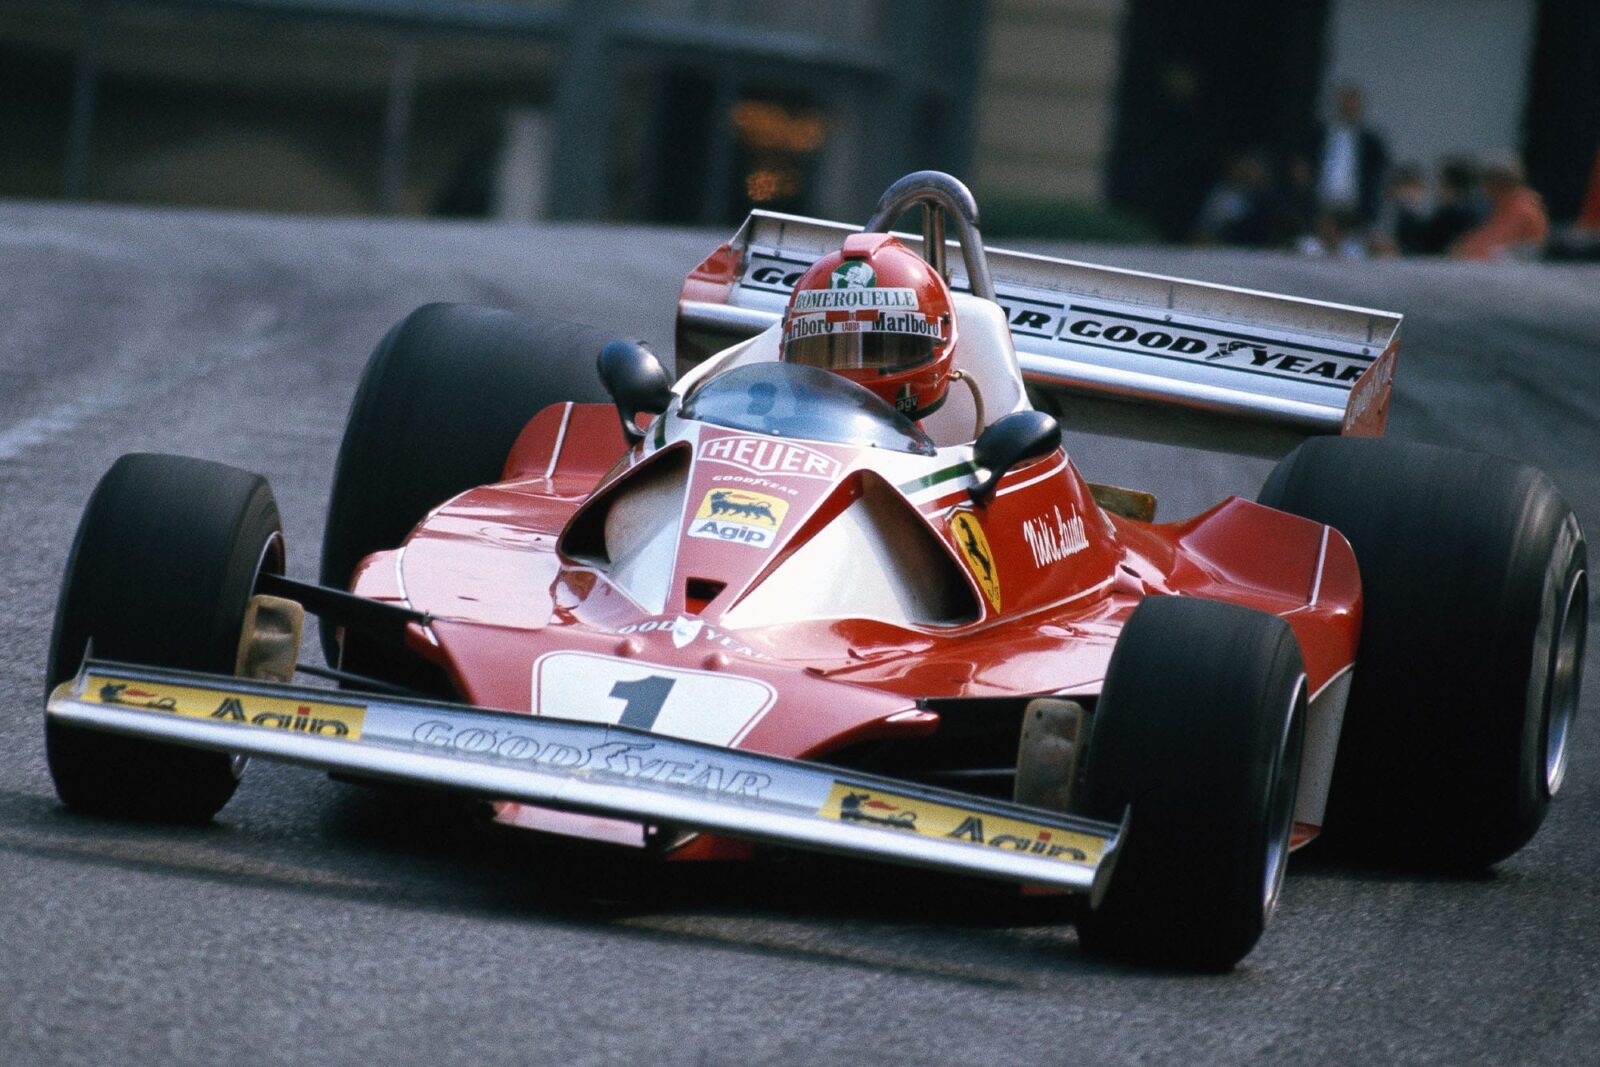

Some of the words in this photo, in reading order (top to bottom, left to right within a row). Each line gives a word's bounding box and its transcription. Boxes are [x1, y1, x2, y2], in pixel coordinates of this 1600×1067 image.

[872, 312, 939, 336] Marlboro
[709, 439, 828, 474] HEUER
[695, 521, 766, 543] Agip
[609, 675, 676, 732] 1
